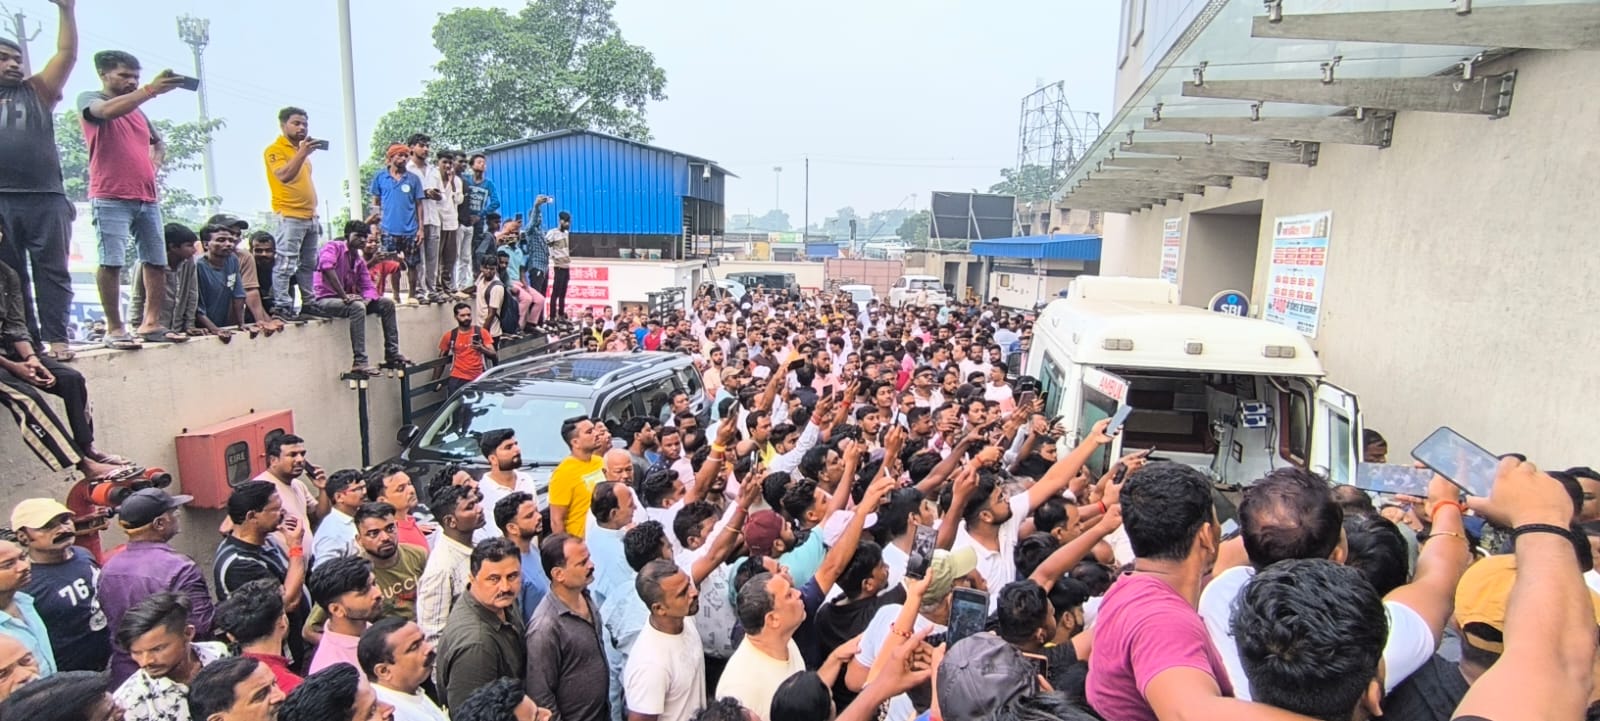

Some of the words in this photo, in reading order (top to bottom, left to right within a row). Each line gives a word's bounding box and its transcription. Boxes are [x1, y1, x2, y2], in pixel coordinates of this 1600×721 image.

[1220, 303, 1242, 316] SBI
[58, 577, 90, 607] 76
[383, 574, 419, 599] UCCI
